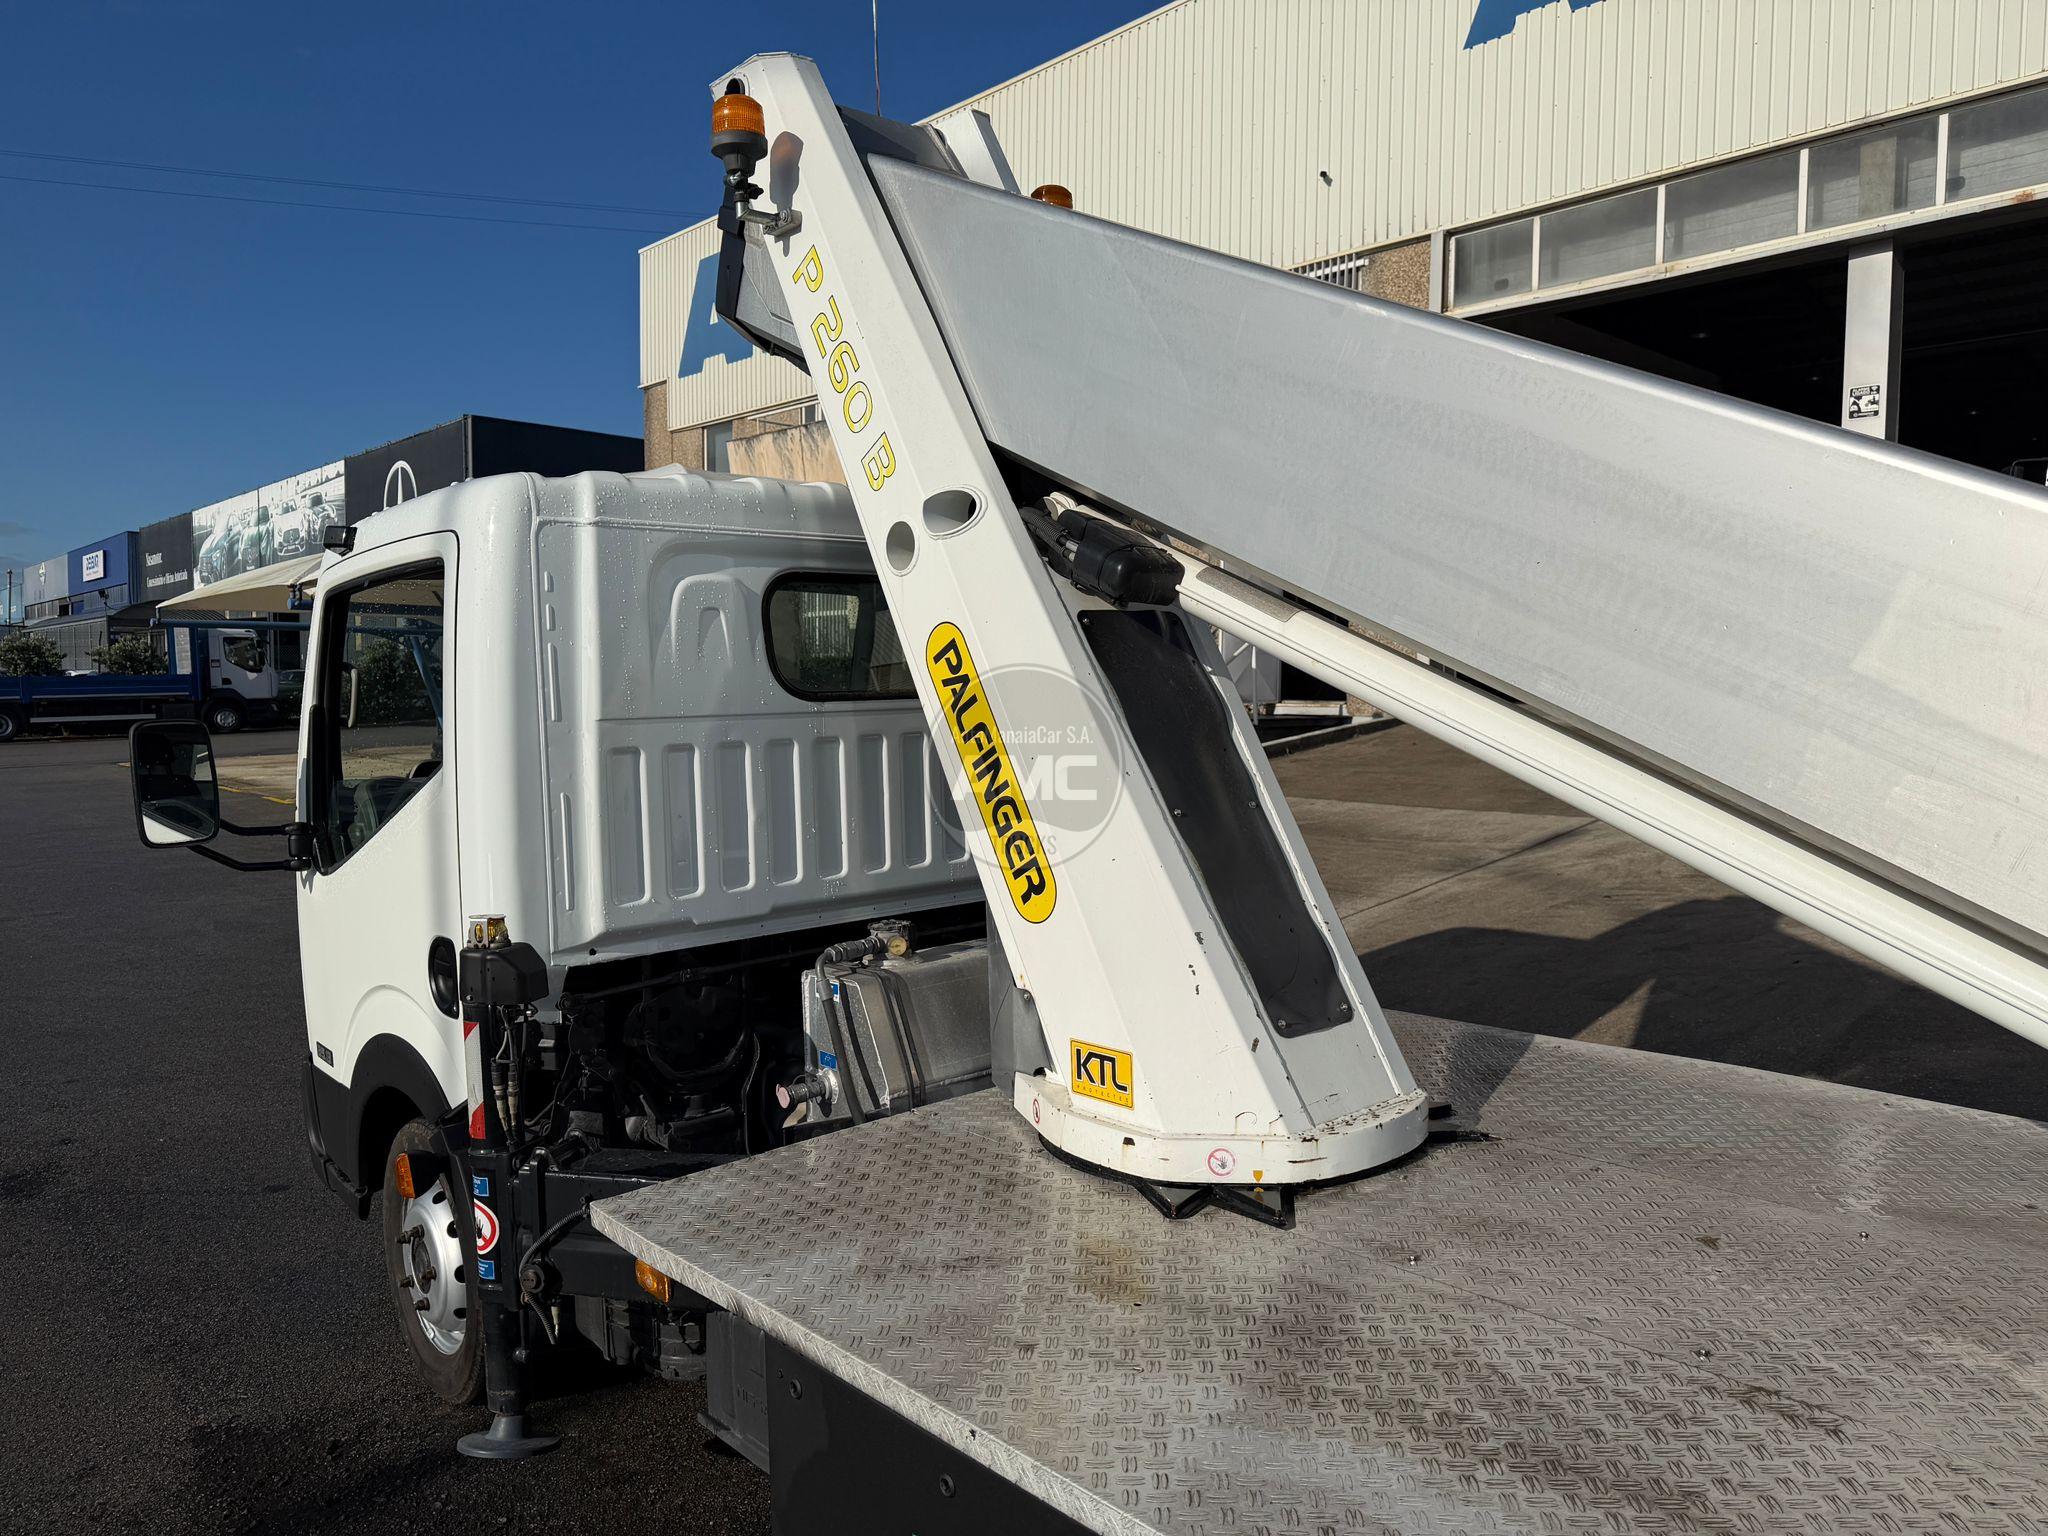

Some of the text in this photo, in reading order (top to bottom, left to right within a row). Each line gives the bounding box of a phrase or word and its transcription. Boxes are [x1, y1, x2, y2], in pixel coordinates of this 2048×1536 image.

[791, 244, 897, 492] P 260 B
[932, 637, 1047, 906] PALFINGER
[1075, 1047, 1128, 1093] KTL
